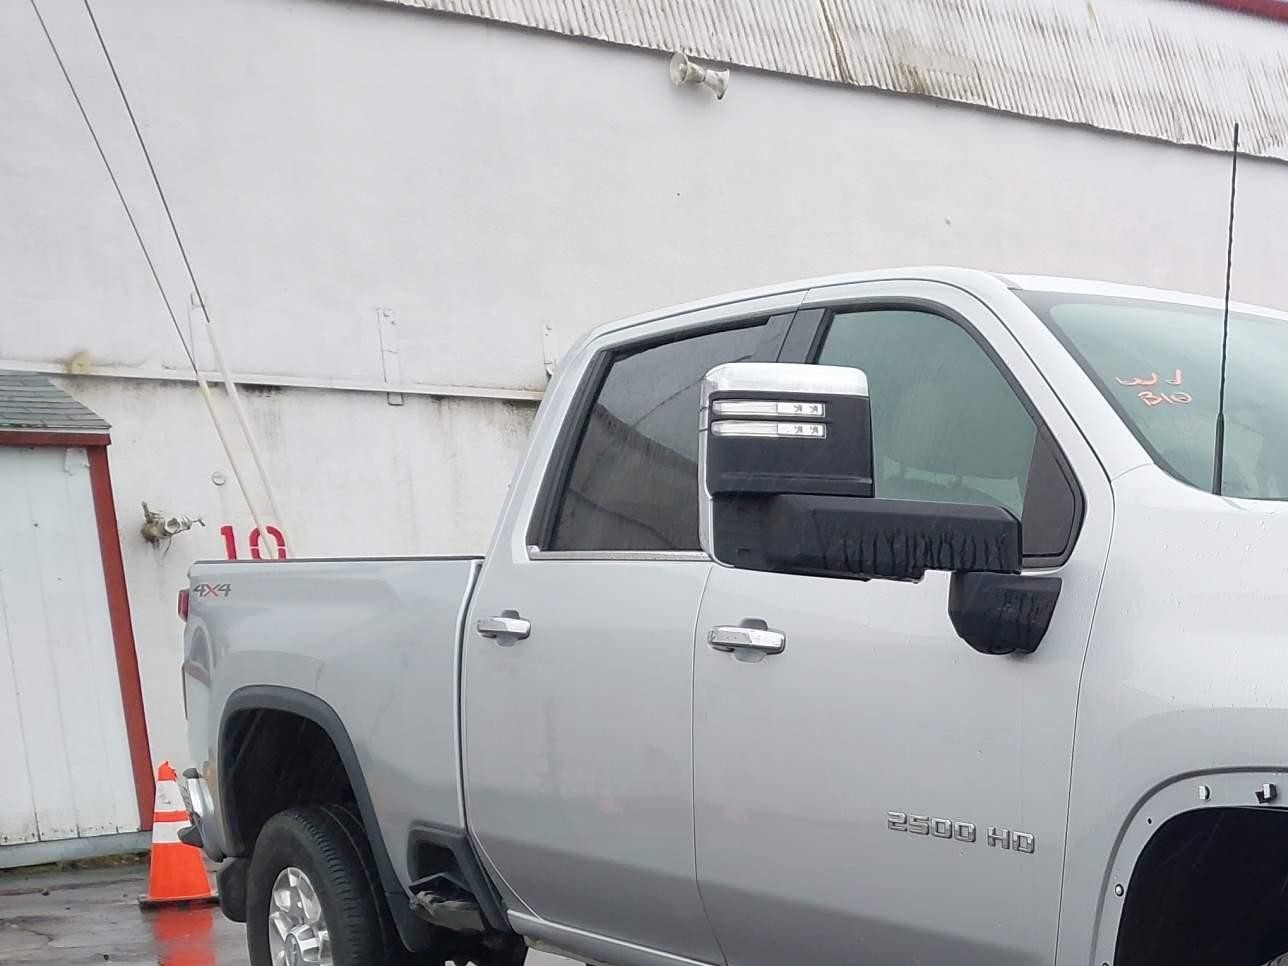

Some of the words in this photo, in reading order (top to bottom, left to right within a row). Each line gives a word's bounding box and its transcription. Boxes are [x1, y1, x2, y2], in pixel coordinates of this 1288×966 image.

[220, 525, 287, 560] 10
[887, 810, 976, 843] 2500
[986, 826, 1036, 854] HD
